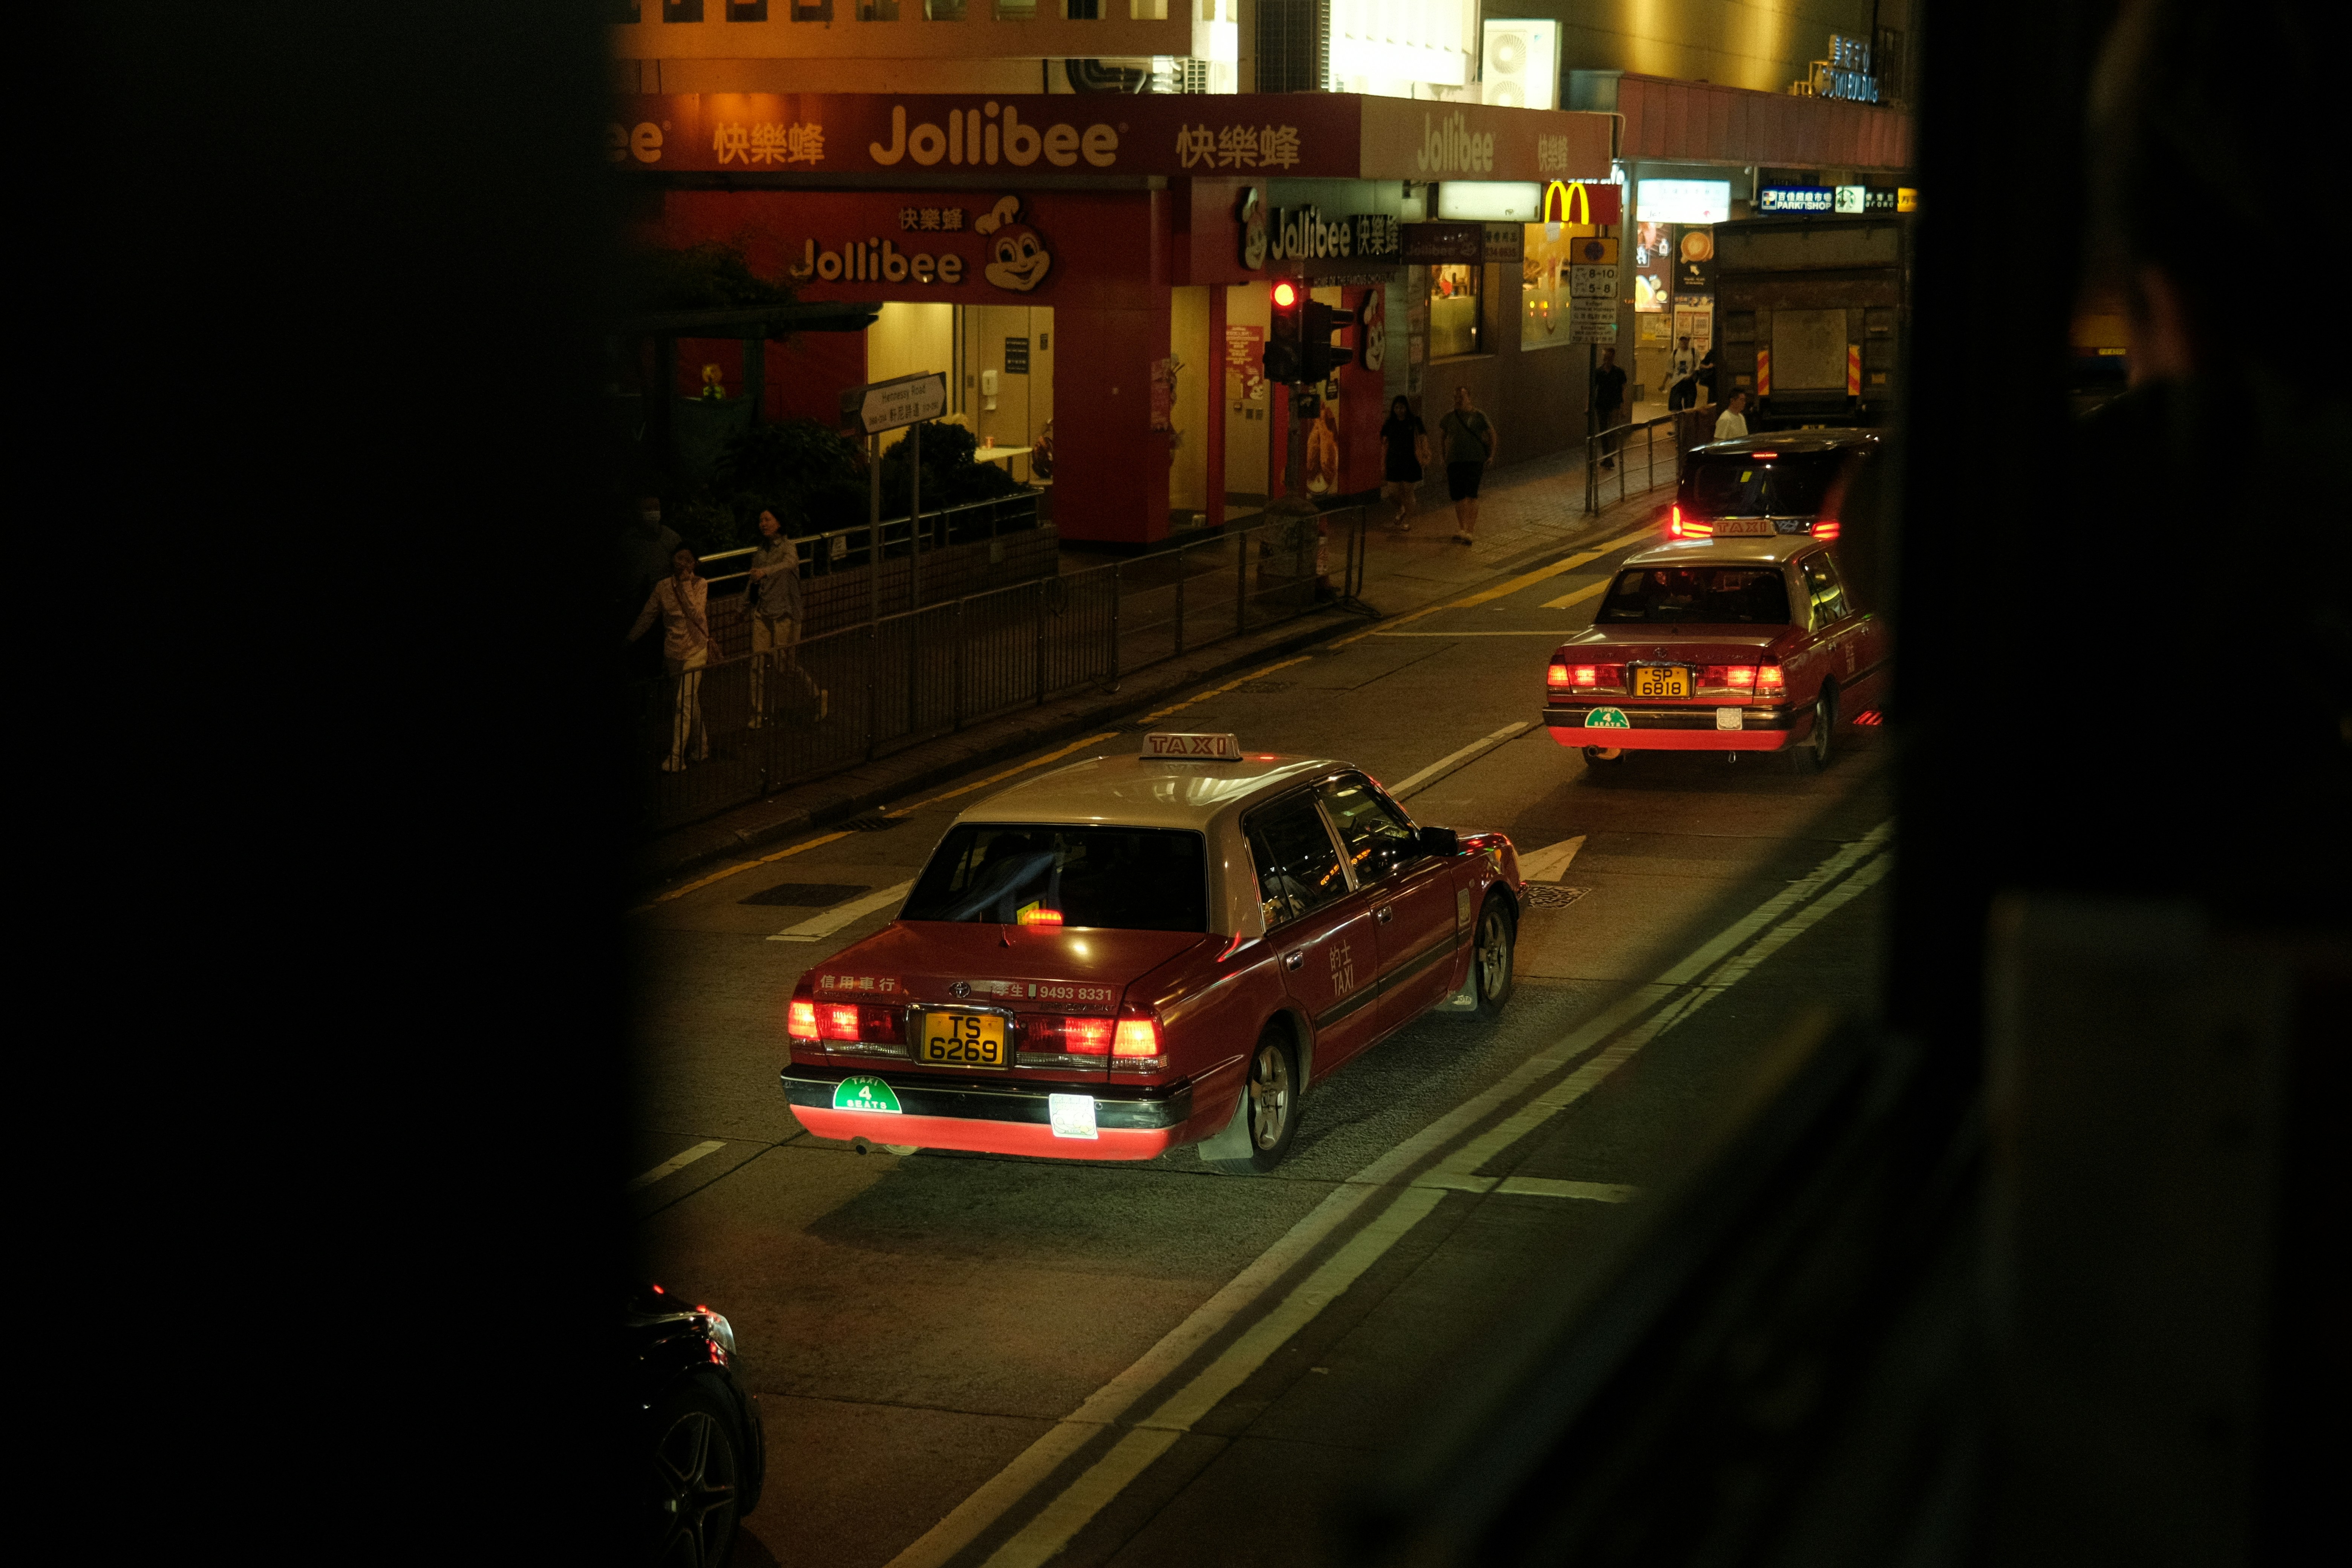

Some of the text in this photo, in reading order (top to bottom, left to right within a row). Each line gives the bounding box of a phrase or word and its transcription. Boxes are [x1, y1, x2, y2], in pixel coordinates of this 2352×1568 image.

[713, 122, 825, 165] 快樂蜂
[869, 101, 1119, 167] Jollibee
[1417, 110, 1494, 173] Jollibee
[1176, 124, 1301, 169] 快樂蜂
[899, 207, 963, 231] 快樂蜂
[1271, 204, 1351, 260] Jollibee
[1356, 215, 1399, 256] 快樂蜂
[791, 237, 962, 283] Jollibee
[882, 384, 926, 403] Hennessy Road
[1716, 521, 1767, 534] TAXI
[1652, 669, 1673, 682] SP
[1642, 682, 1681, 696] 6818
[1602, 713, 1612, 722] 4
[1149, 736, 1227, 755] TAXI
[1329, 939, 1352, 972] 的士
[820, 974, 896, 992] 信用車行
[1331, 963, 1354, 997] TAXI
[1040, 986, 1074, 999] 9493
[1078, 988, 1112, 1001] 8331
[948, 1016, 981, 1038] TS
[929, 1038, 997, 1062] 6269
[852, 1077, 879, 1086] TAXI
[858, 1085, 872, 1100] 4
[847, 1099, 887, 1109] SEATS
